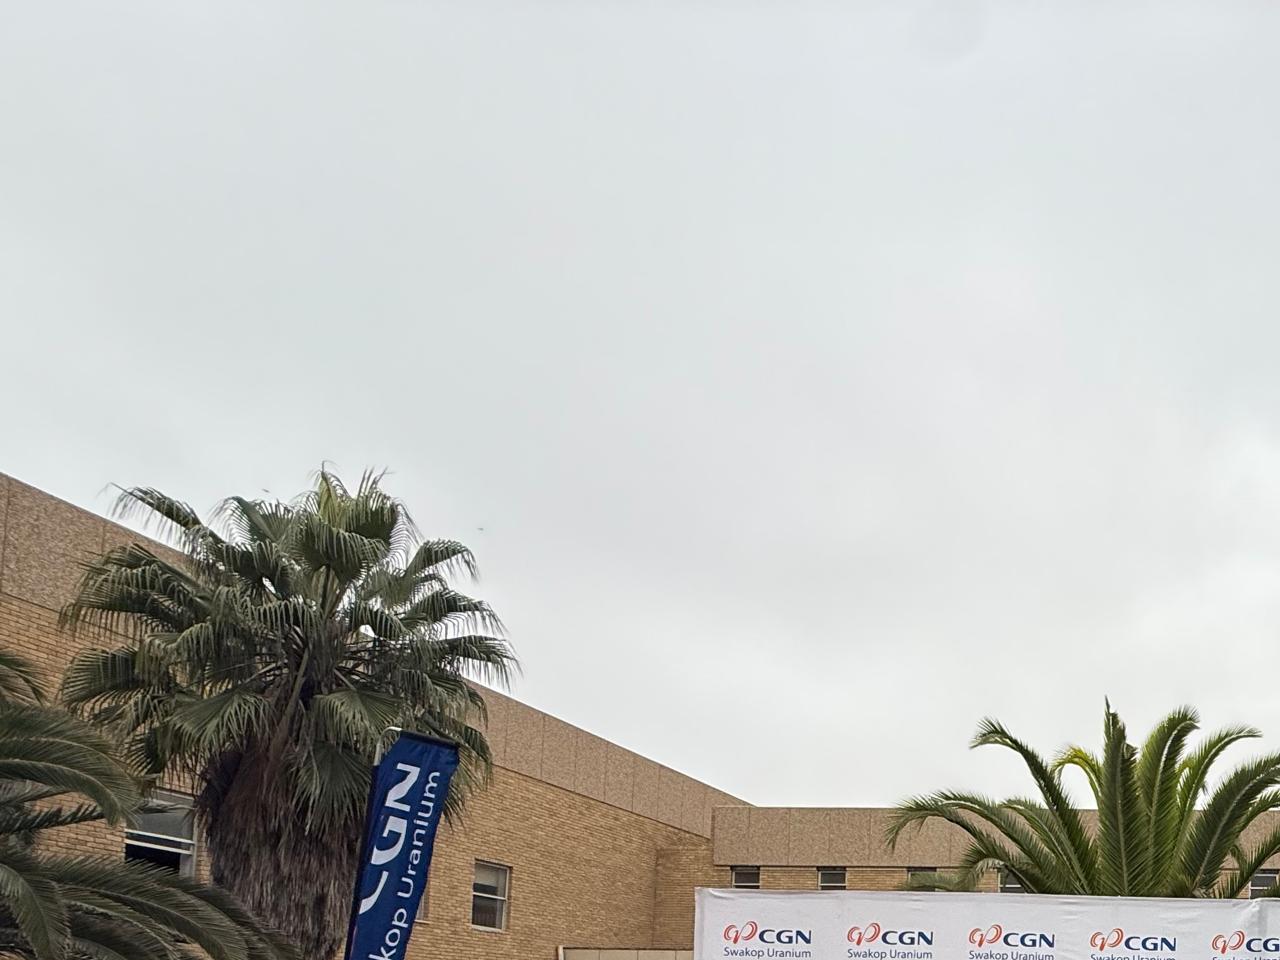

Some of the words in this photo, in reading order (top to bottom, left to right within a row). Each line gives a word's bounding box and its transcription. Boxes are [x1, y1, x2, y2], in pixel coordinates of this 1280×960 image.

[396, 771, 441, 899] Uranium
[759, 929, 812, 945] CGN
[881, 931, 933, 946] CGN
[1003, 932, 1055, 948] CGN
[1124, 936, 1176, 951] CGN
[724, 947, 764, 958] Swakop
[767, 948, 811, 958] Uranium
[847, 948, 887, 960] Swakop
[889, 950, 932, 960] Uranium
